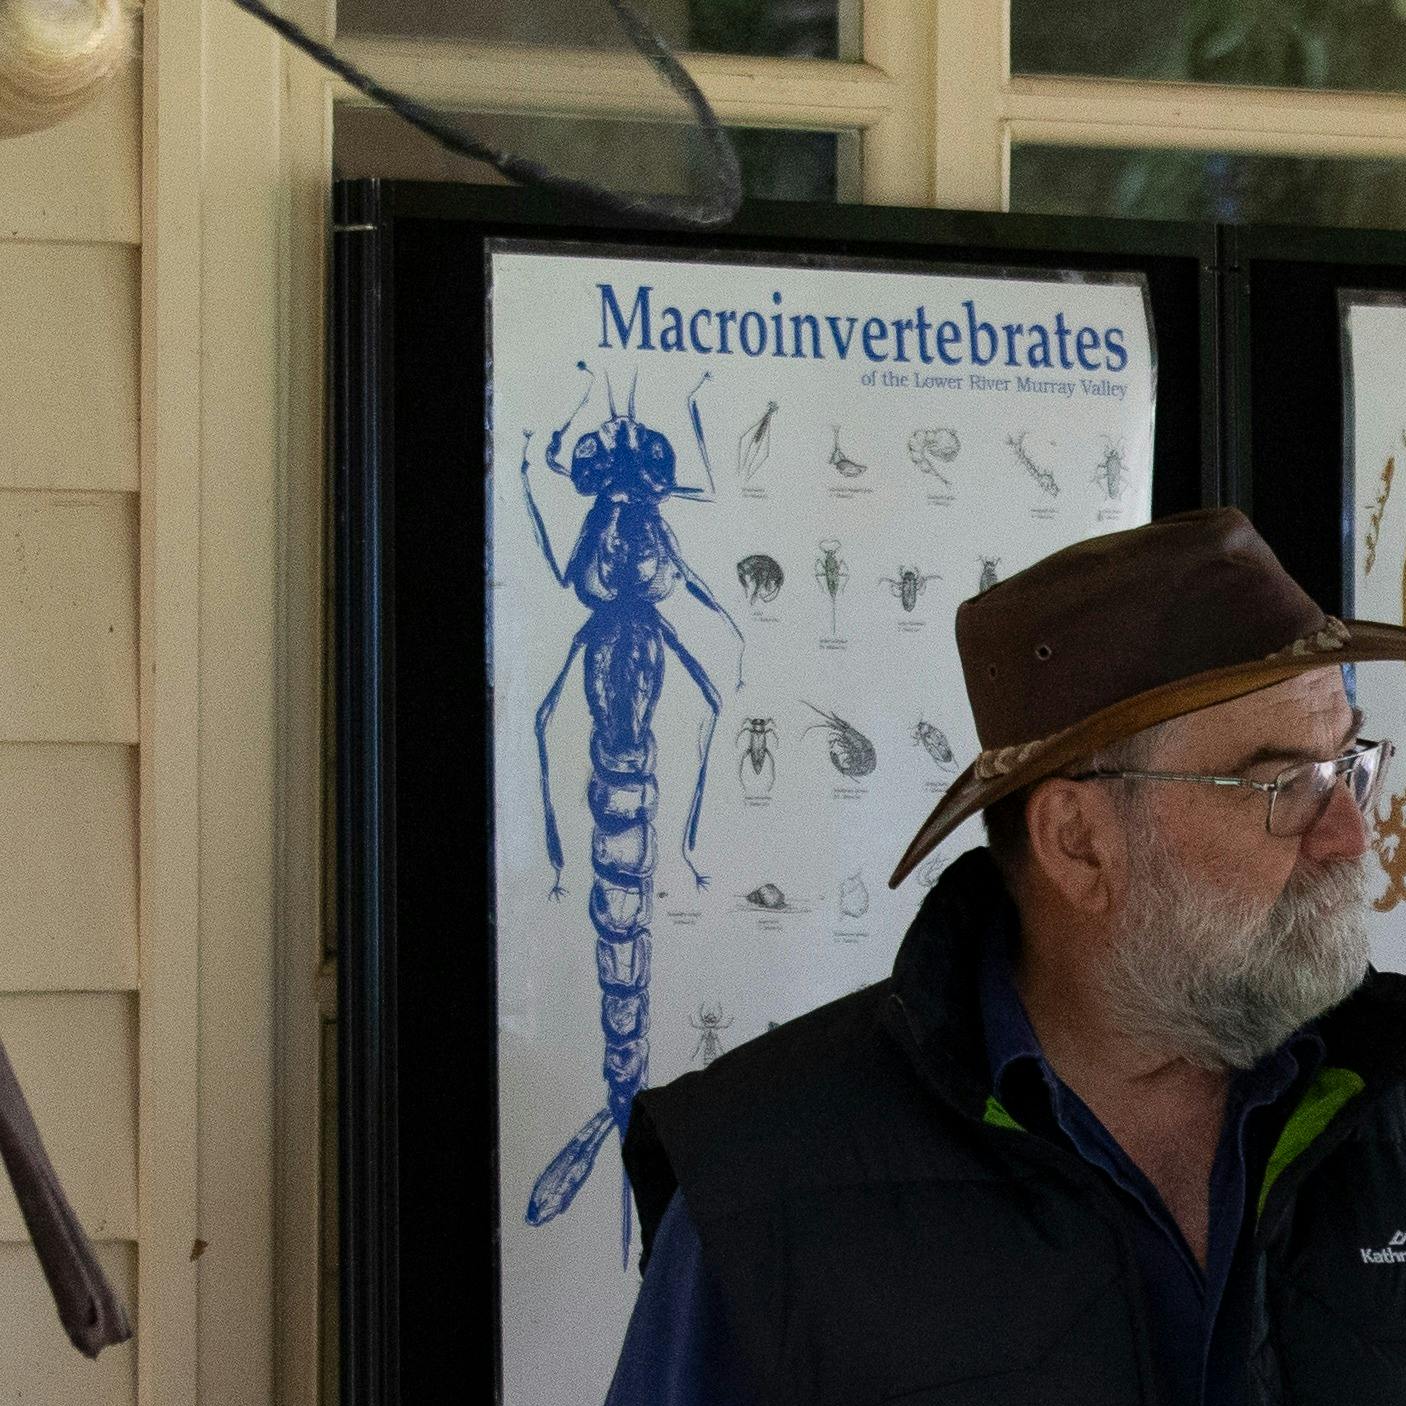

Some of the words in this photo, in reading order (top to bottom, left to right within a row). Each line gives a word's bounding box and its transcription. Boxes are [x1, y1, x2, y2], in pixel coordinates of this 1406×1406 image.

[596, 284, 1128, 372] Macroinvertebrates
[861, 371, 878, 387] of
[882, 372, 908, 388] the
[914, 373, 963, 390] Lower
[969, 375, 1011, 391] River
[1016, 376, 1076, 398] Murray
[1081, 379, 1128, 400] Valley
